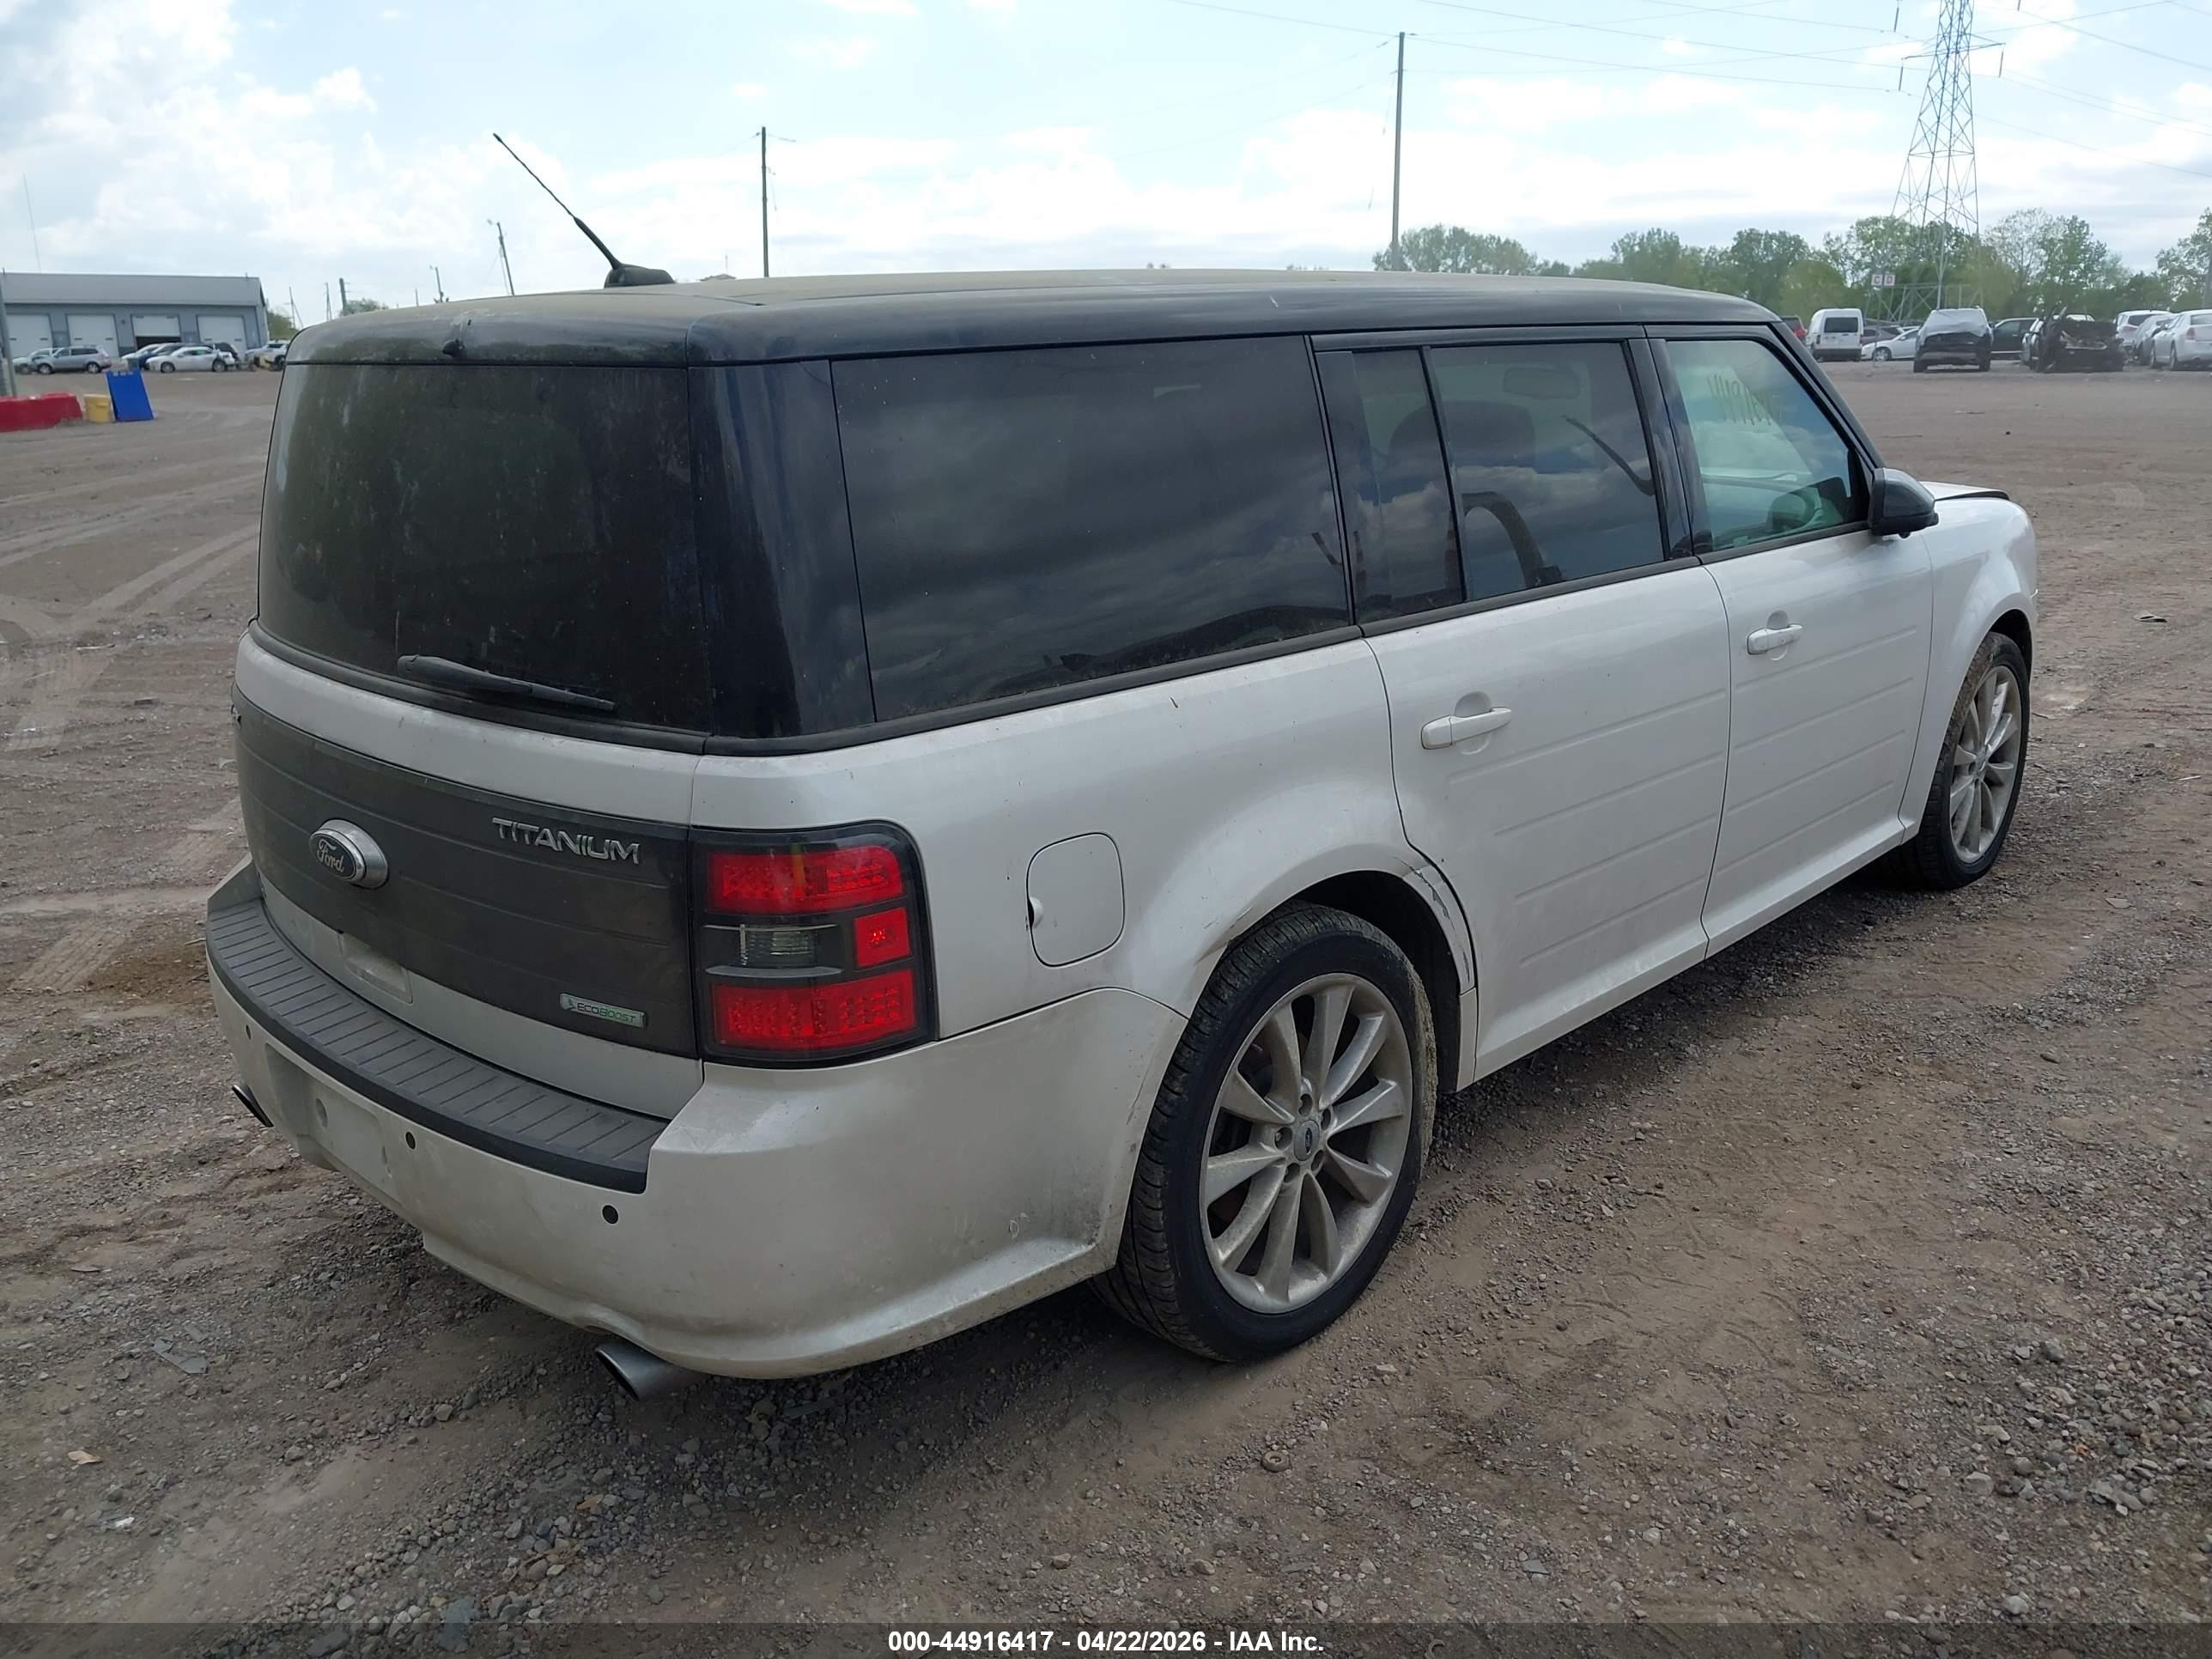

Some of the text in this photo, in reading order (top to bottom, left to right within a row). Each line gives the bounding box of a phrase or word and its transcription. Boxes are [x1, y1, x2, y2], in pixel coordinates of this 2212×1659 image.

[316, 838, 345, 873] Ford
[492, 817, 641, 865] TITANIUM
[577, 1002, 636, 1024] ECOBOOST
